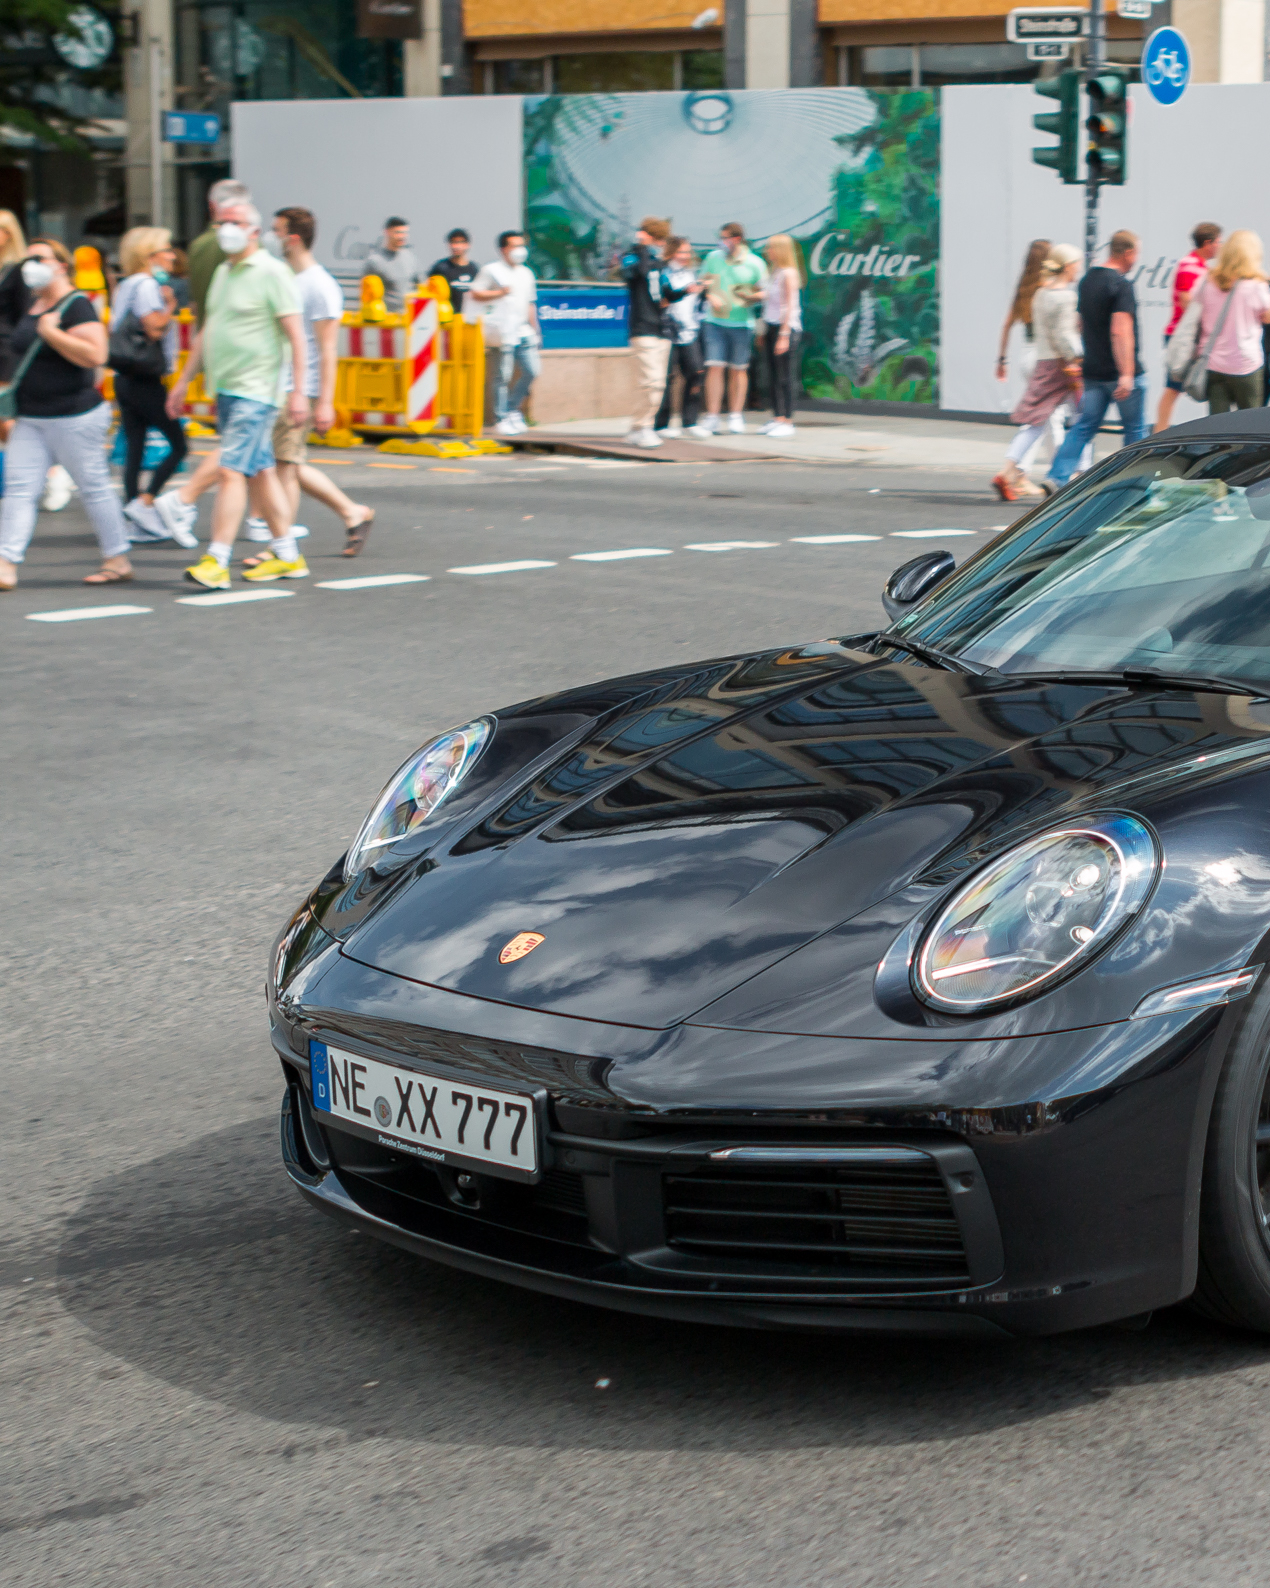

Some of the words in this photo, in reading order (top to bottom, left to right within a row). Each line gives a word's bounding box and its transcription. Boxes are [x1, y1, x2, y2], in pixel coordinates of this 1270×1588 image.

[810, 232, 920, 276] Cartier
[318, 1083, 326, 1098] D
[330, 1055, 371, 1118] NE
[394, 1076, 442, 1139] XX
[451, 1090, 527, 1156] 777
[378, 1134, 397, 1148] Porsche
